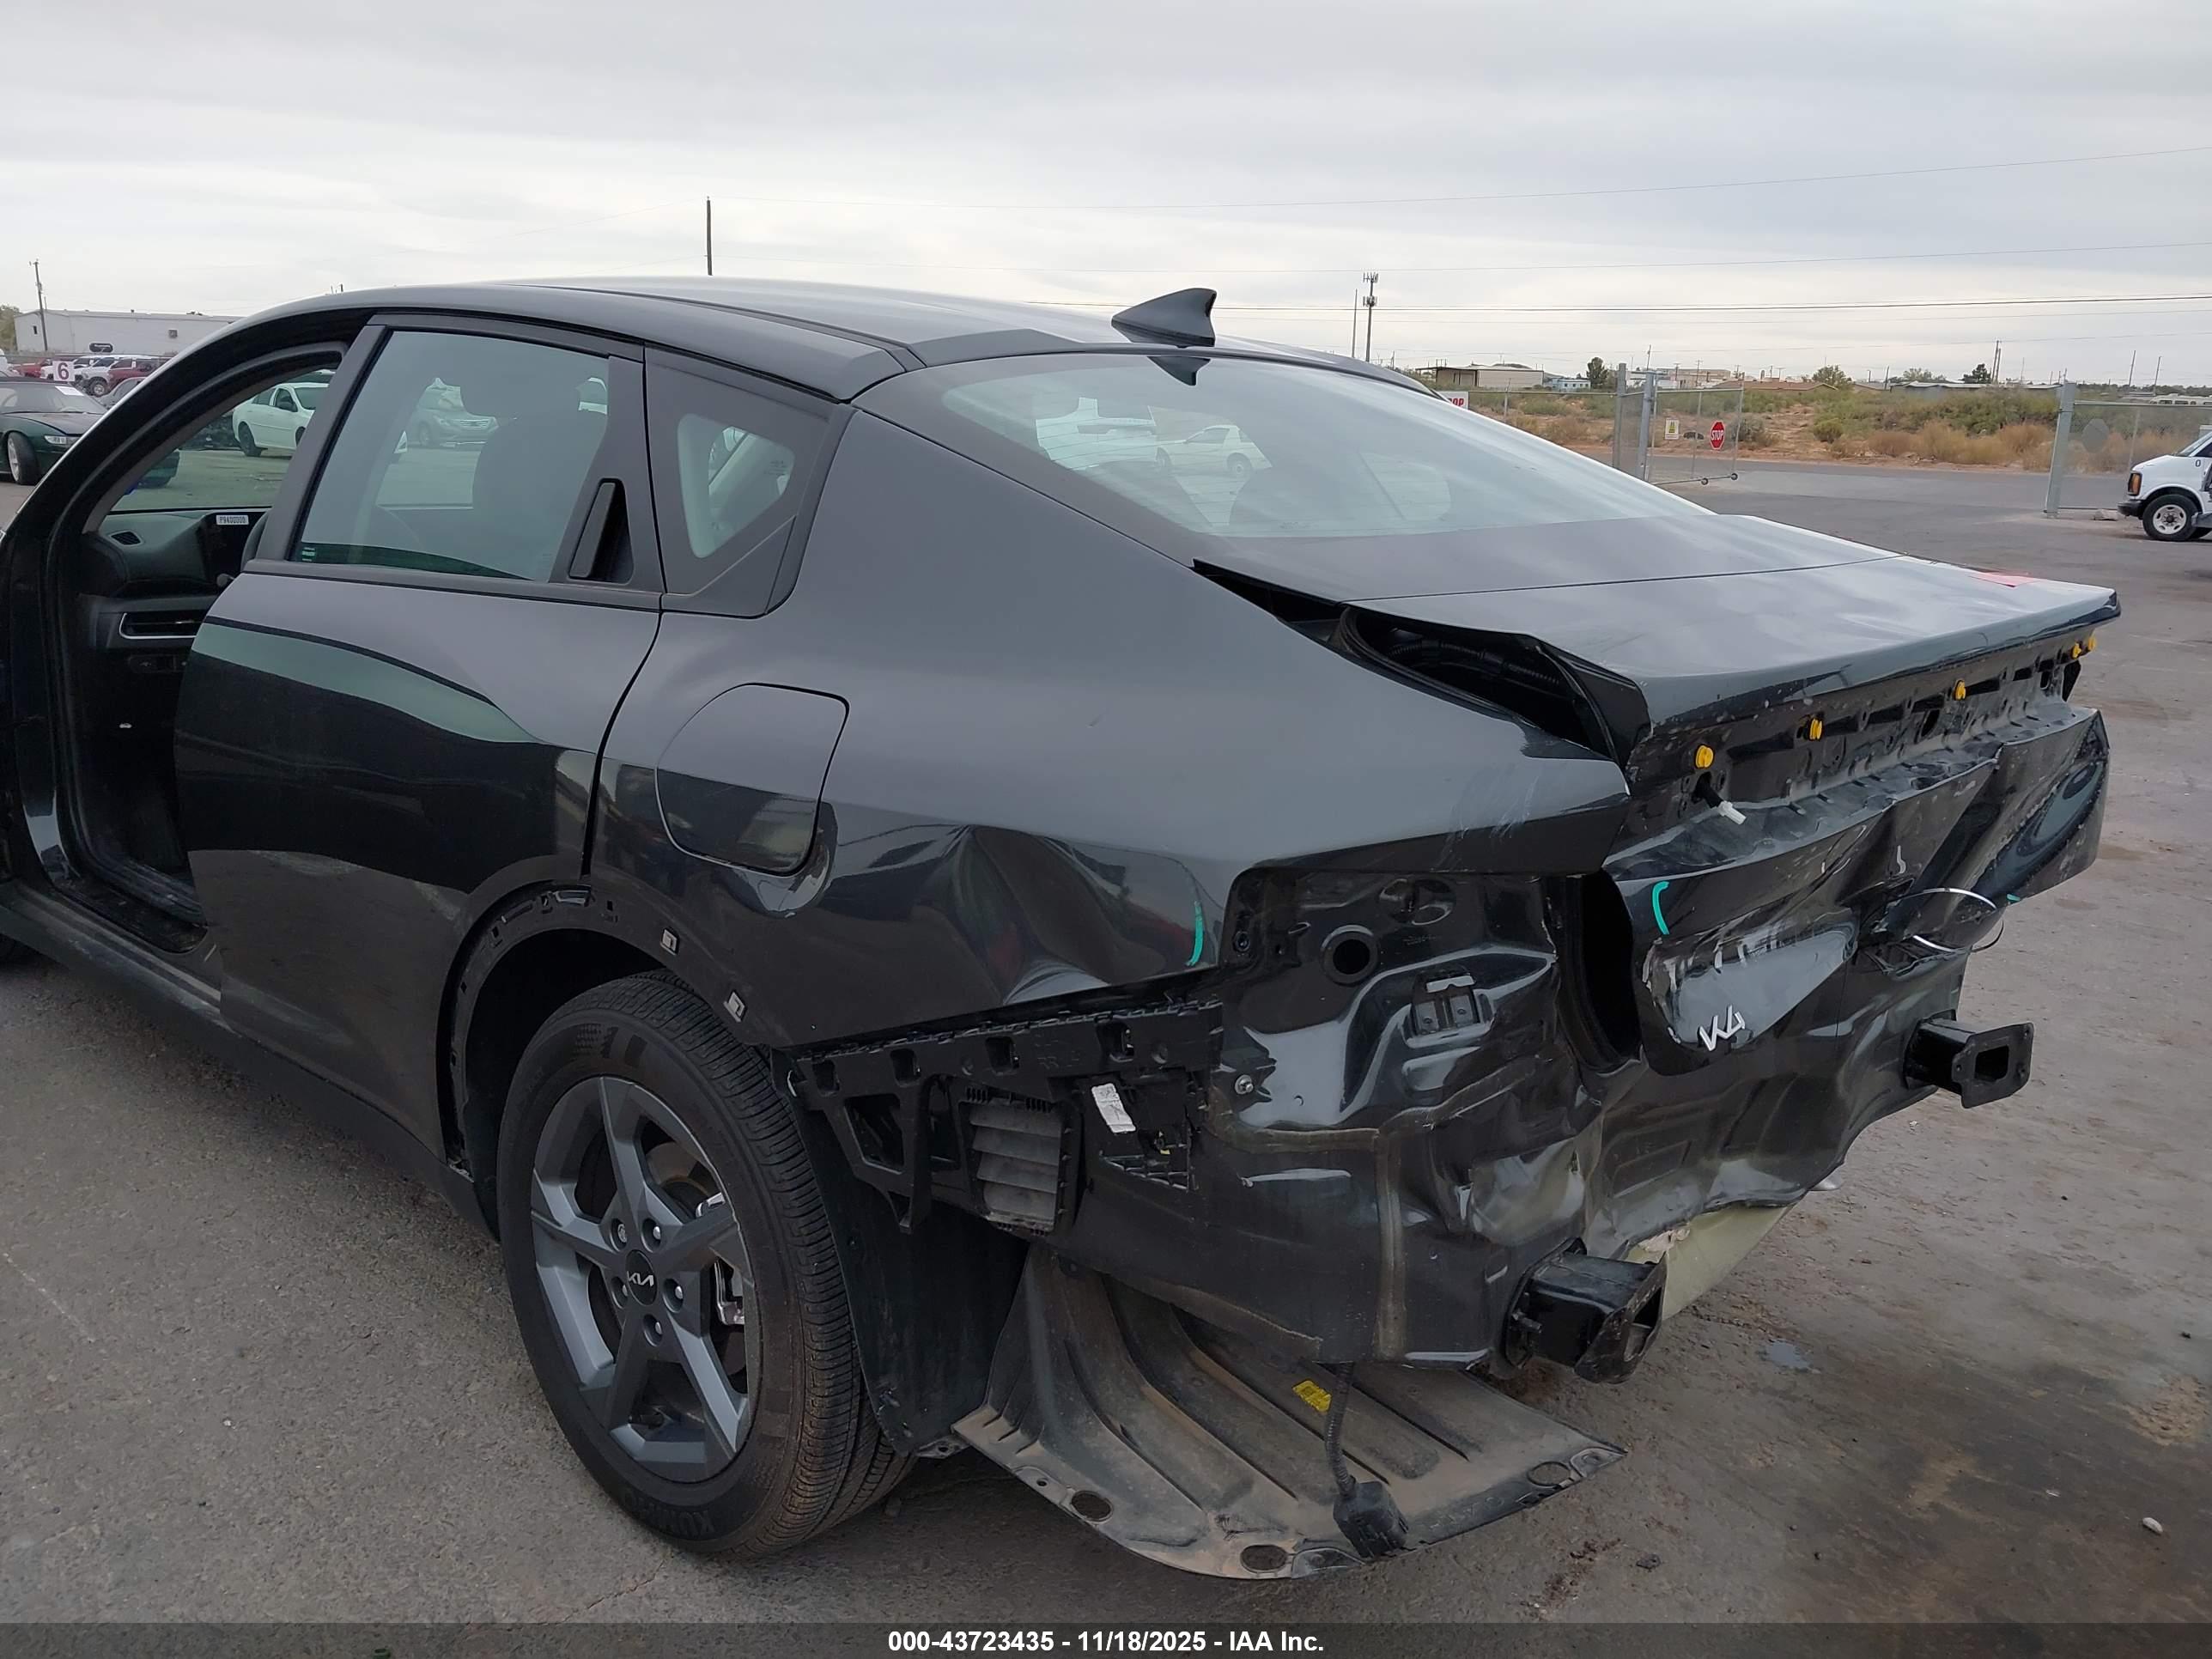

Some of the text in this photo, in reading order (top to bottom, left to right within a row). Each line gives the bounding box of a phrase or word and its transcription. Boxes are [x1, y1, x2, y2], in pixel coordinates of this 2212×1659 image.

[58, 362, 70, 380] 6
[1711, 429, 1724, 441] STOP
[626, 1270, 654, 1287] KIA
